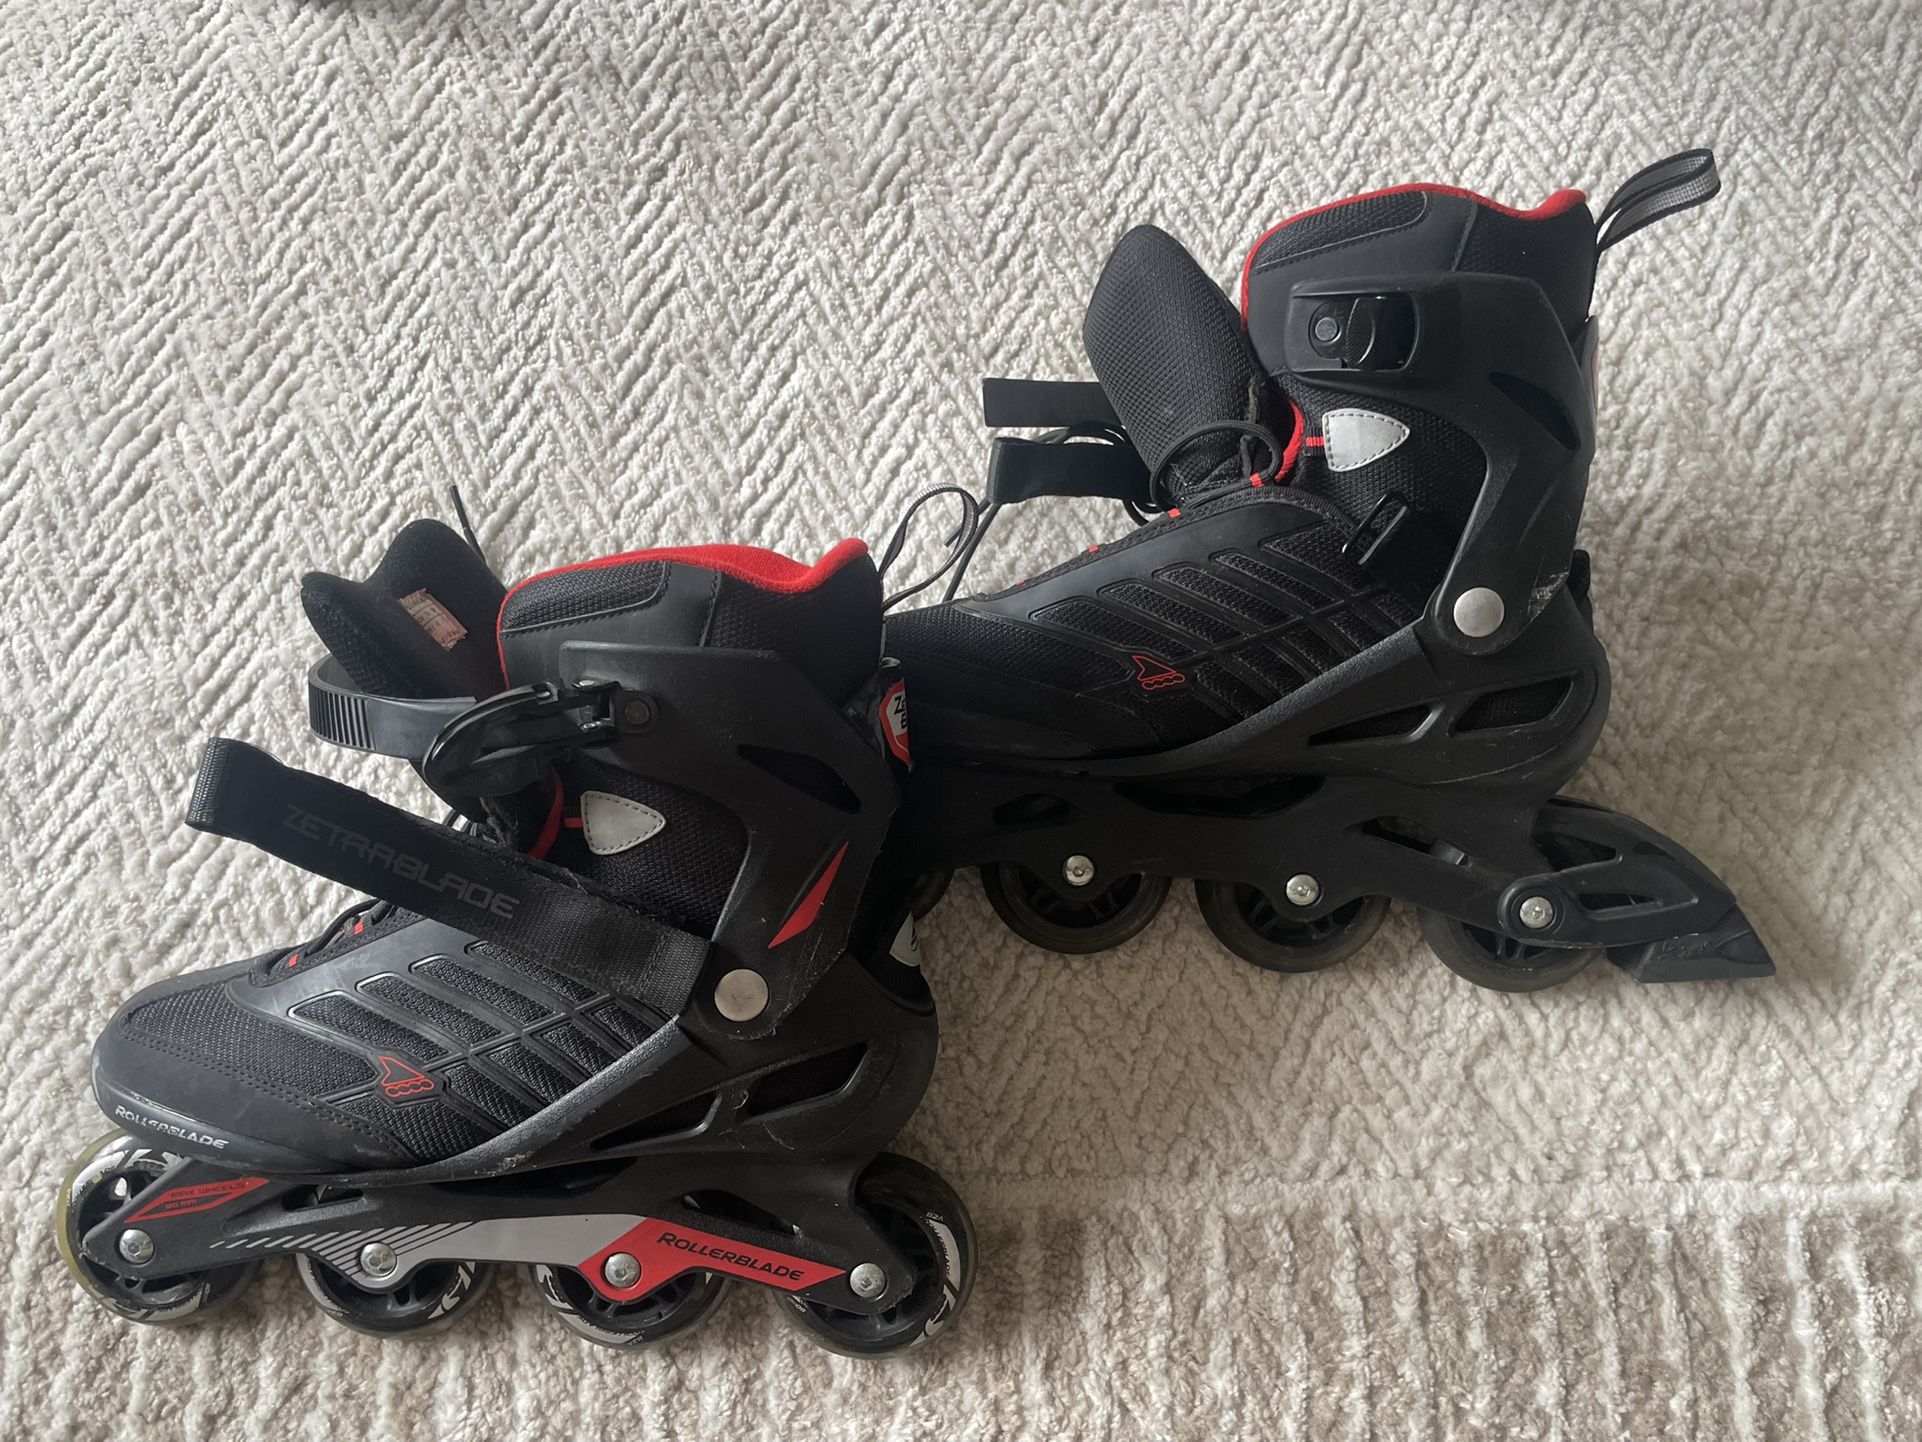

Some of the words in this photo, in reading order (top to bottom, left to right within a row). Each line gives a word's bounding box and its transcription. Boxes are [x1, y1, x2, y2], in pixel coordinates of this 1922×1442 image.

[283, 803, 520, 920] ZETRABLADE
[115, 1104, 229, 1149] ROLLERBLADE
[656, 1231, 805, 1281] ROLLERBLADE
